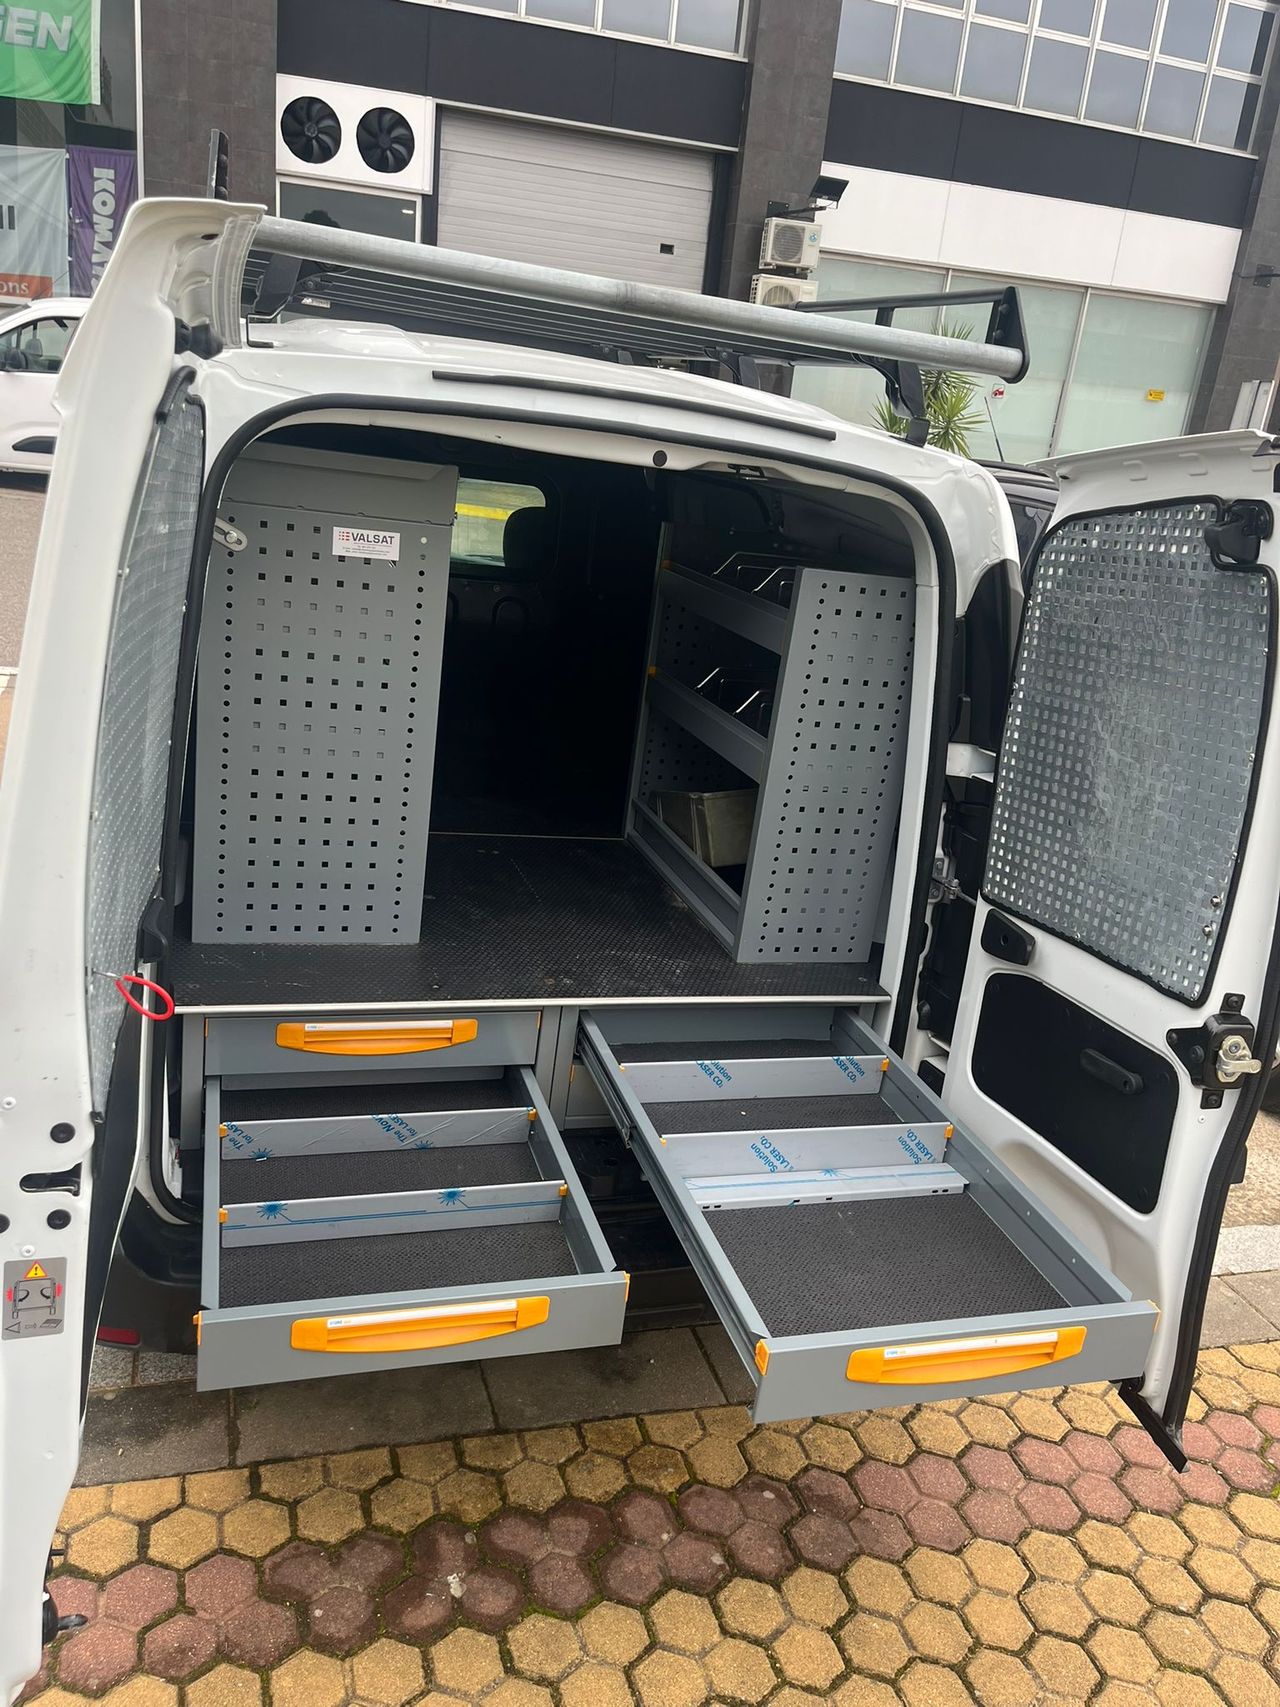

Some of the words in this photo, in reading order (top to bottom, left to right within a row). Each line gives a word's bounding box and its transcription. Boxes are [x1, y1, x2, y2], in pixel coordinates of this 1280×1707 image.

[351, 532, 395, 545] VALSAT
[710, 1060, 733, 1082] olution
[846, 1057, 865, 1077] olution
[242, 1134, 255, 1145] for
[393, 1129, 407, 1143] The
[407, 1126, 418, 1137] for
[228, 1136, 244, 1150] The
[897, 1136, 922, 1165] Solution
[915, 1140, 933, 1161] LASER
[750, 1143, 778, 1173] Solution
[770, 1147, 790, 1169] LASER
